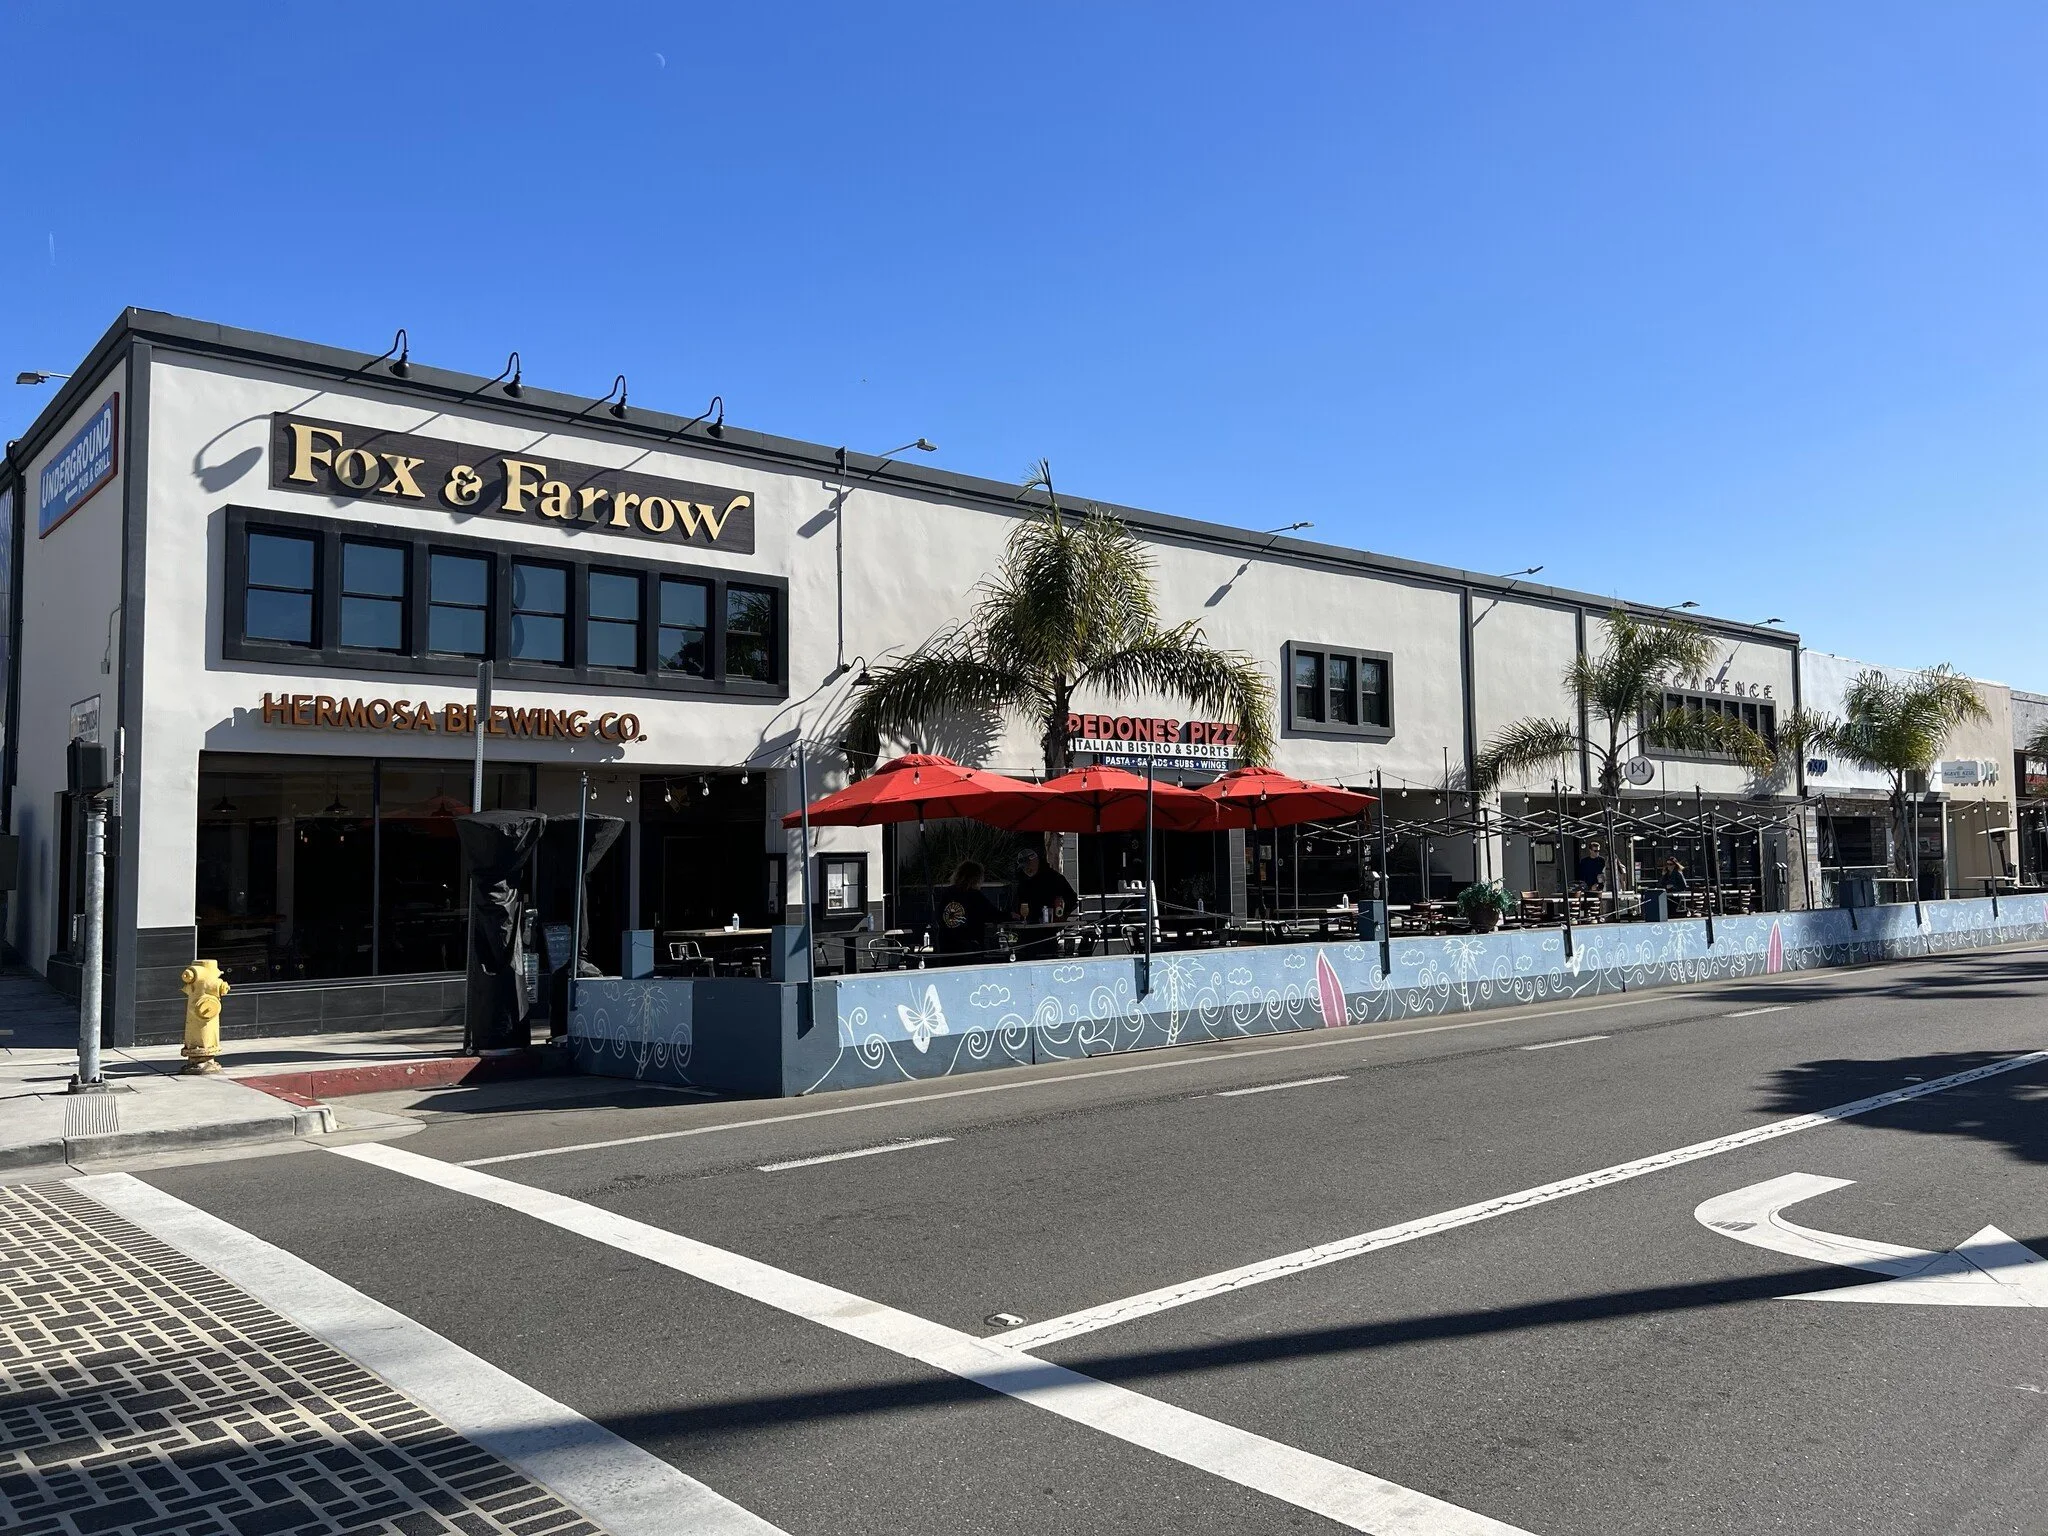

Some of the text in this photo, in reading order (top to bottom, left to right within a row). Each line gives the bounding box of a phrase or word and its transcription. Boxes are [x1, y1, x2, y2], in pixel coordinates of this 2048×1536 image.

[41, 408, 111, 508] UNDERGROUND
[78, 471, 89, 493] PUB
[94, 451, 111, 478] GRILL
[289, 423, 751, 541] Fox & Farrow
[263, 693, 437, 731] HERMOSA
[599, 712, 648, 742] CO.
[1068, 713, 1239, 746] PEDONES PIZZ
[1076, 739, 1123, 752] TALIAN
[1127, 742, 1171, 754] BISTRO
[1175, 745, 1182, 755] &
[1185, 745, 1229, 758] SPORTS
[1105, 756, 1227, 769] PASTA SAADS SUBS WINGS
